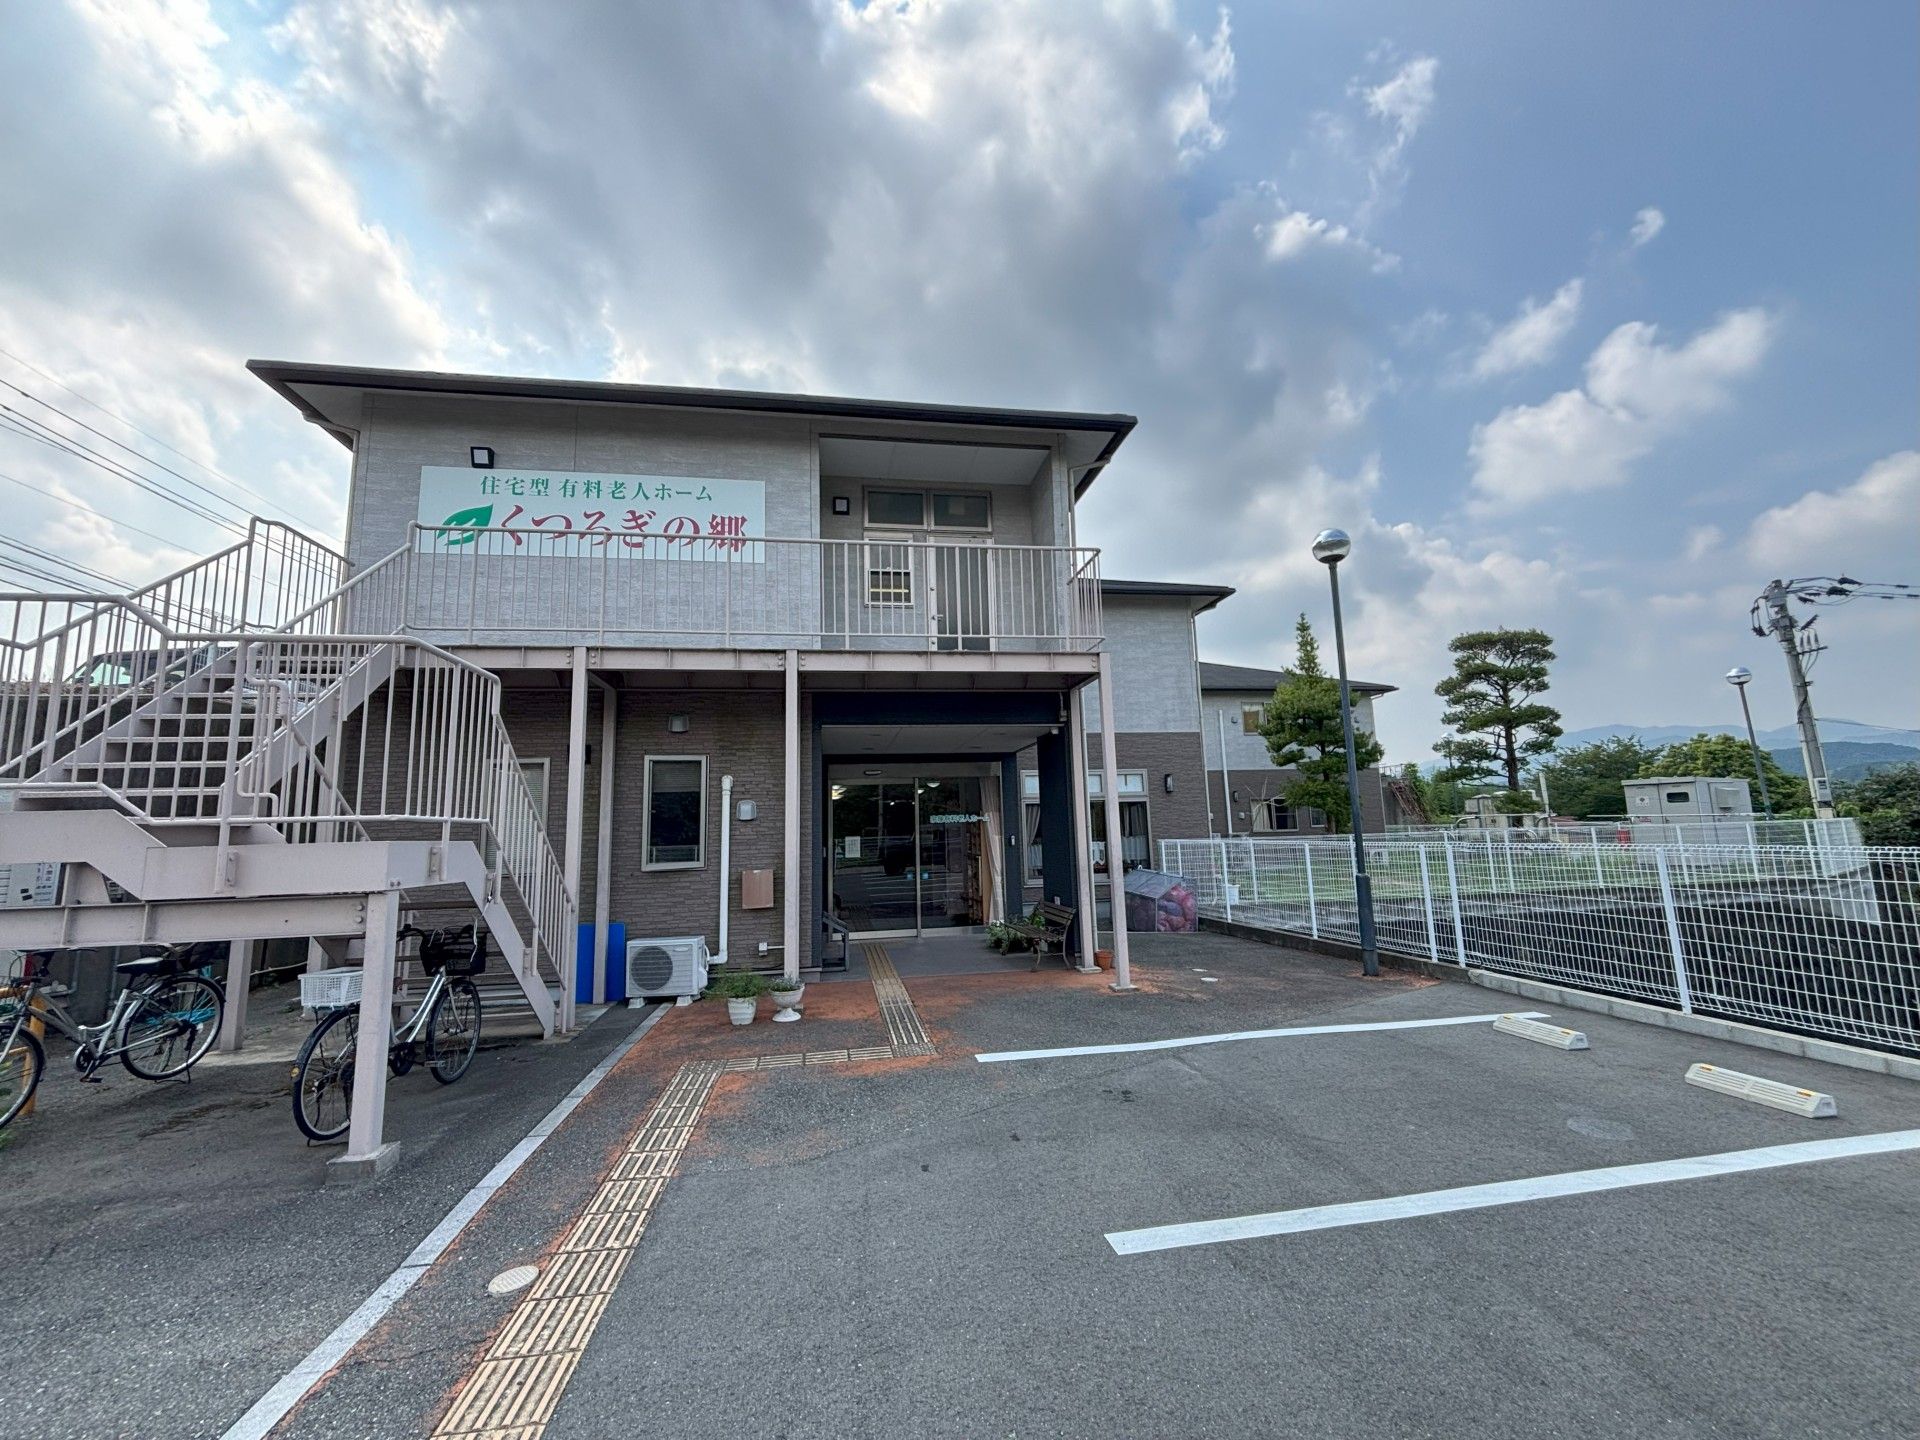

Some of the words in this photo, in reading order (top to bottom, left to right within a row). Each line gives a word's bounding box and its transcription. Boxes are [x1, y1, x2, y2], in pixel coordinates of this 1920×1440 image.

[500, 504, 748, 553] くつろぎの郷
